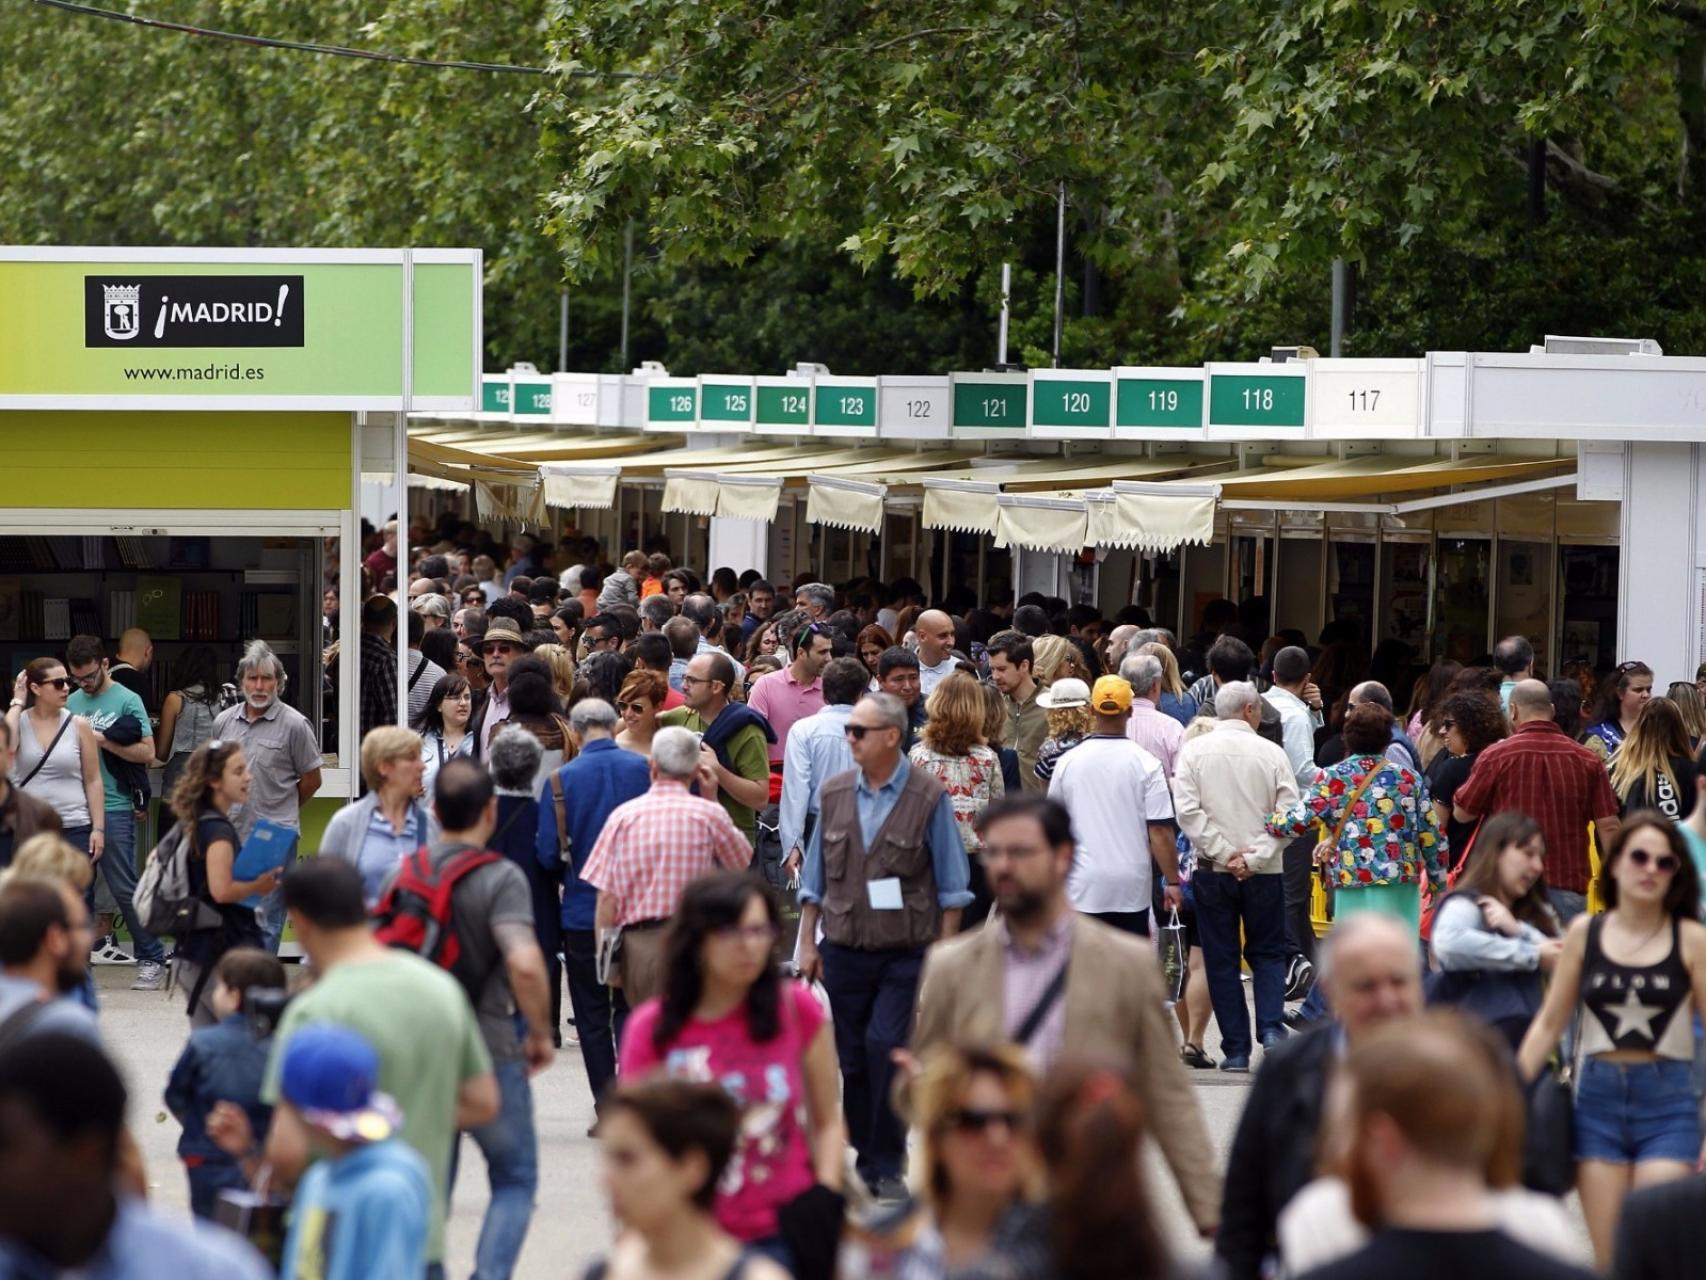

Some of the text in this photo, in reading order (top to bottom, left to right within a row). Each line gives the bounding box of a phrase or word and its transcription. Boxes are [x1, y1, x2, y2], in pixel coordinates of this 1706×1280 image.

[154, 284, 290, 339] ¡MADRID!
[124, 364, 265, 380] www.madrid.es
[670, 396, 692, 412] 126
[724, 395, 747, 412] 125
[781, 396, 807, 413] 124
[840, 397, 864, 415] 123
[982, 399, 1007, 417] 121
[1062, 393, 1090, 413] 120
[1148, 390, 1178, 411] 119
[1242, 388, 1273, 410] 118
[1348, 389, 1381, 411] 117
[907, 400, 931, 418] 122
